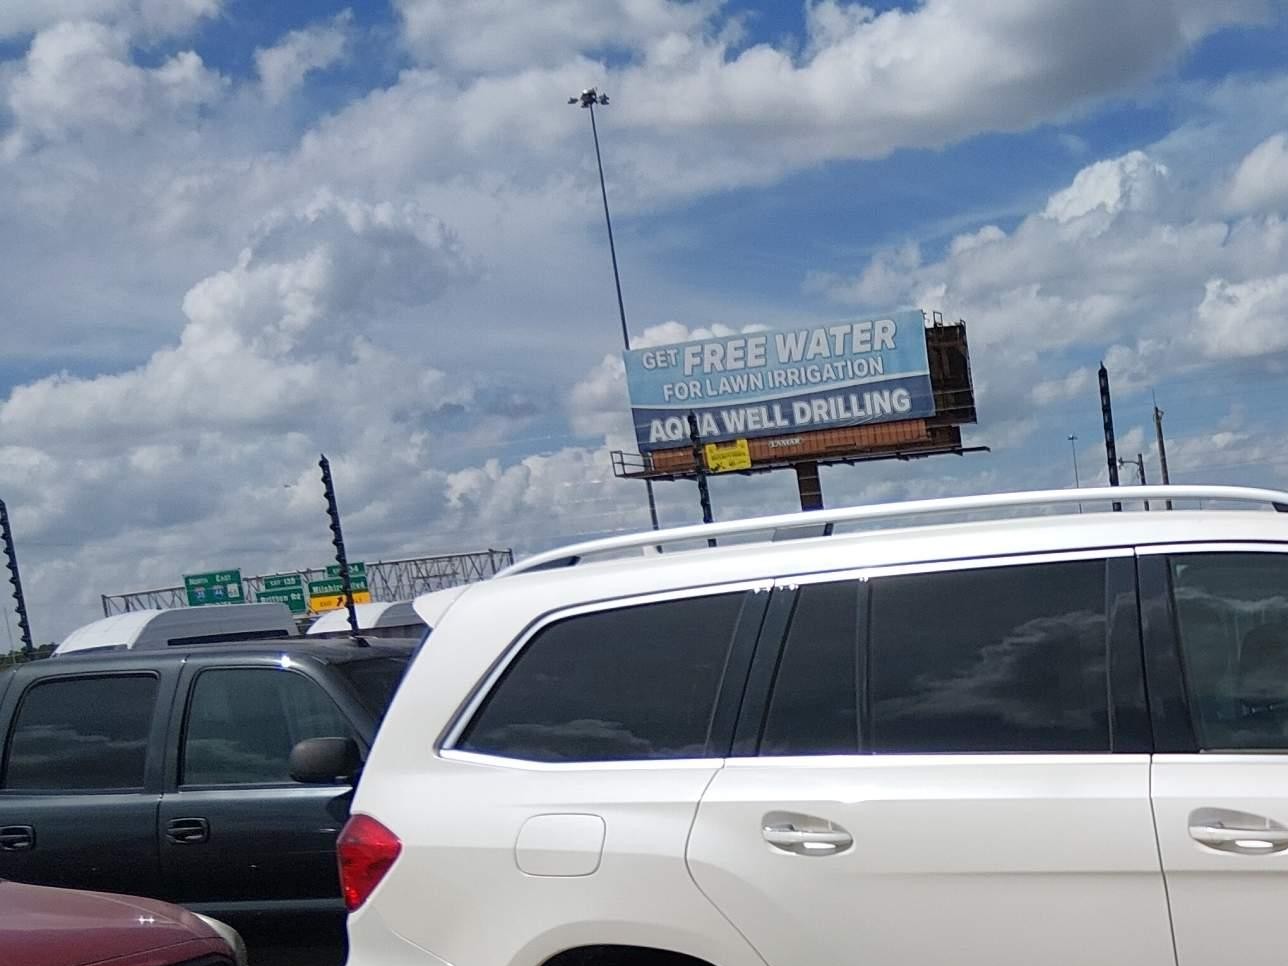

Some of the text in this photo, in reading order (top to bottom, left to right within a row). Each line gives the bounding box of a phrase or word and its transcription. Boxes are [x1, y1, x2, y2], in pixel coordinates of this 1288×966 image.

[642, 319, 897, 377] GET FREE WATER
[663, 356, 885, 402] FOR LAWN IRRIGATION
[721, 403, 789, 434] WELL
[793, 388, 912, 425] DRILLING
